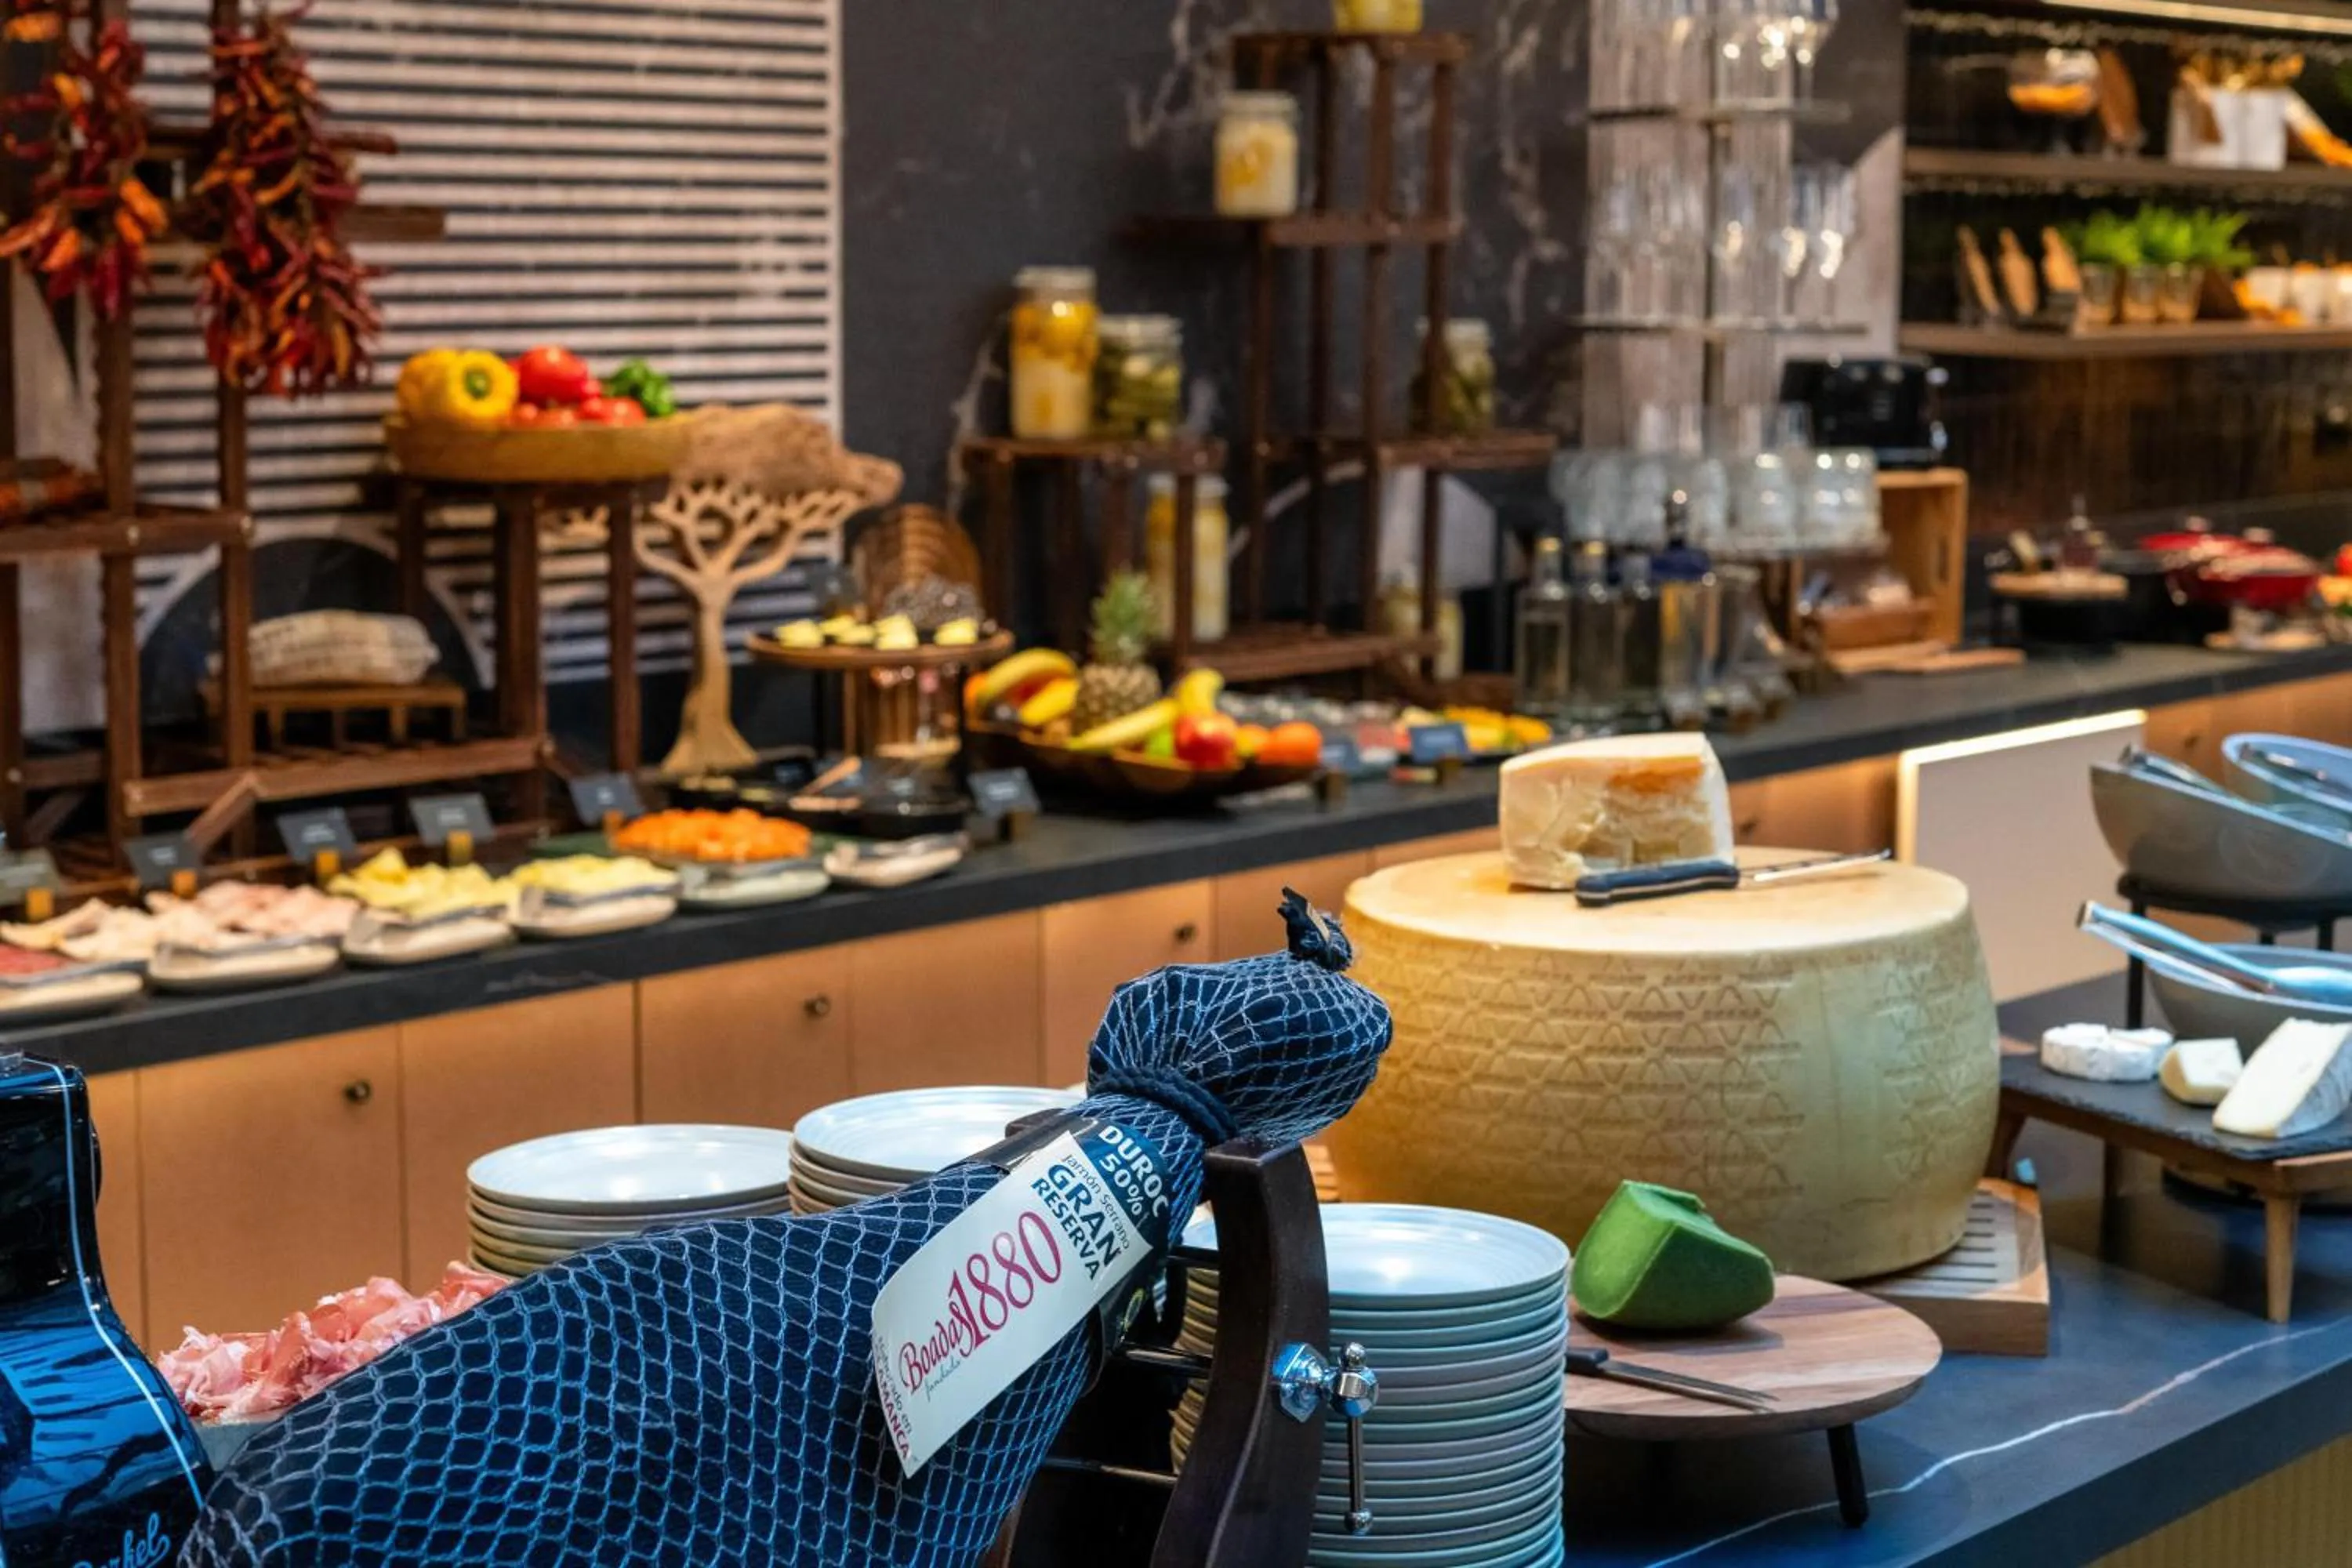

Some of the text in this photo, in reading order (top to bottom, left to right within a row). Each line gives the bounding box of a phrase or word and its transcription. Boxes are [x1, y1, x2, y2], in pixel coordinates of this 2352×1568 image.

[1047, 1164, 1121, 1267] GRAN
[1098, 1125, 1169, 1218] DUROC
[1099, 1153, 1144, 1216] 50%
[1030, 1178, 1101, 1280] RESERVA
[1100, 1194, 1130, 1250] serrano
[948, 1211, 1062, 1350] 1880
[875, 1342, 910, 1461] AMANCA
[73, 1512, 171, 1568] kel
